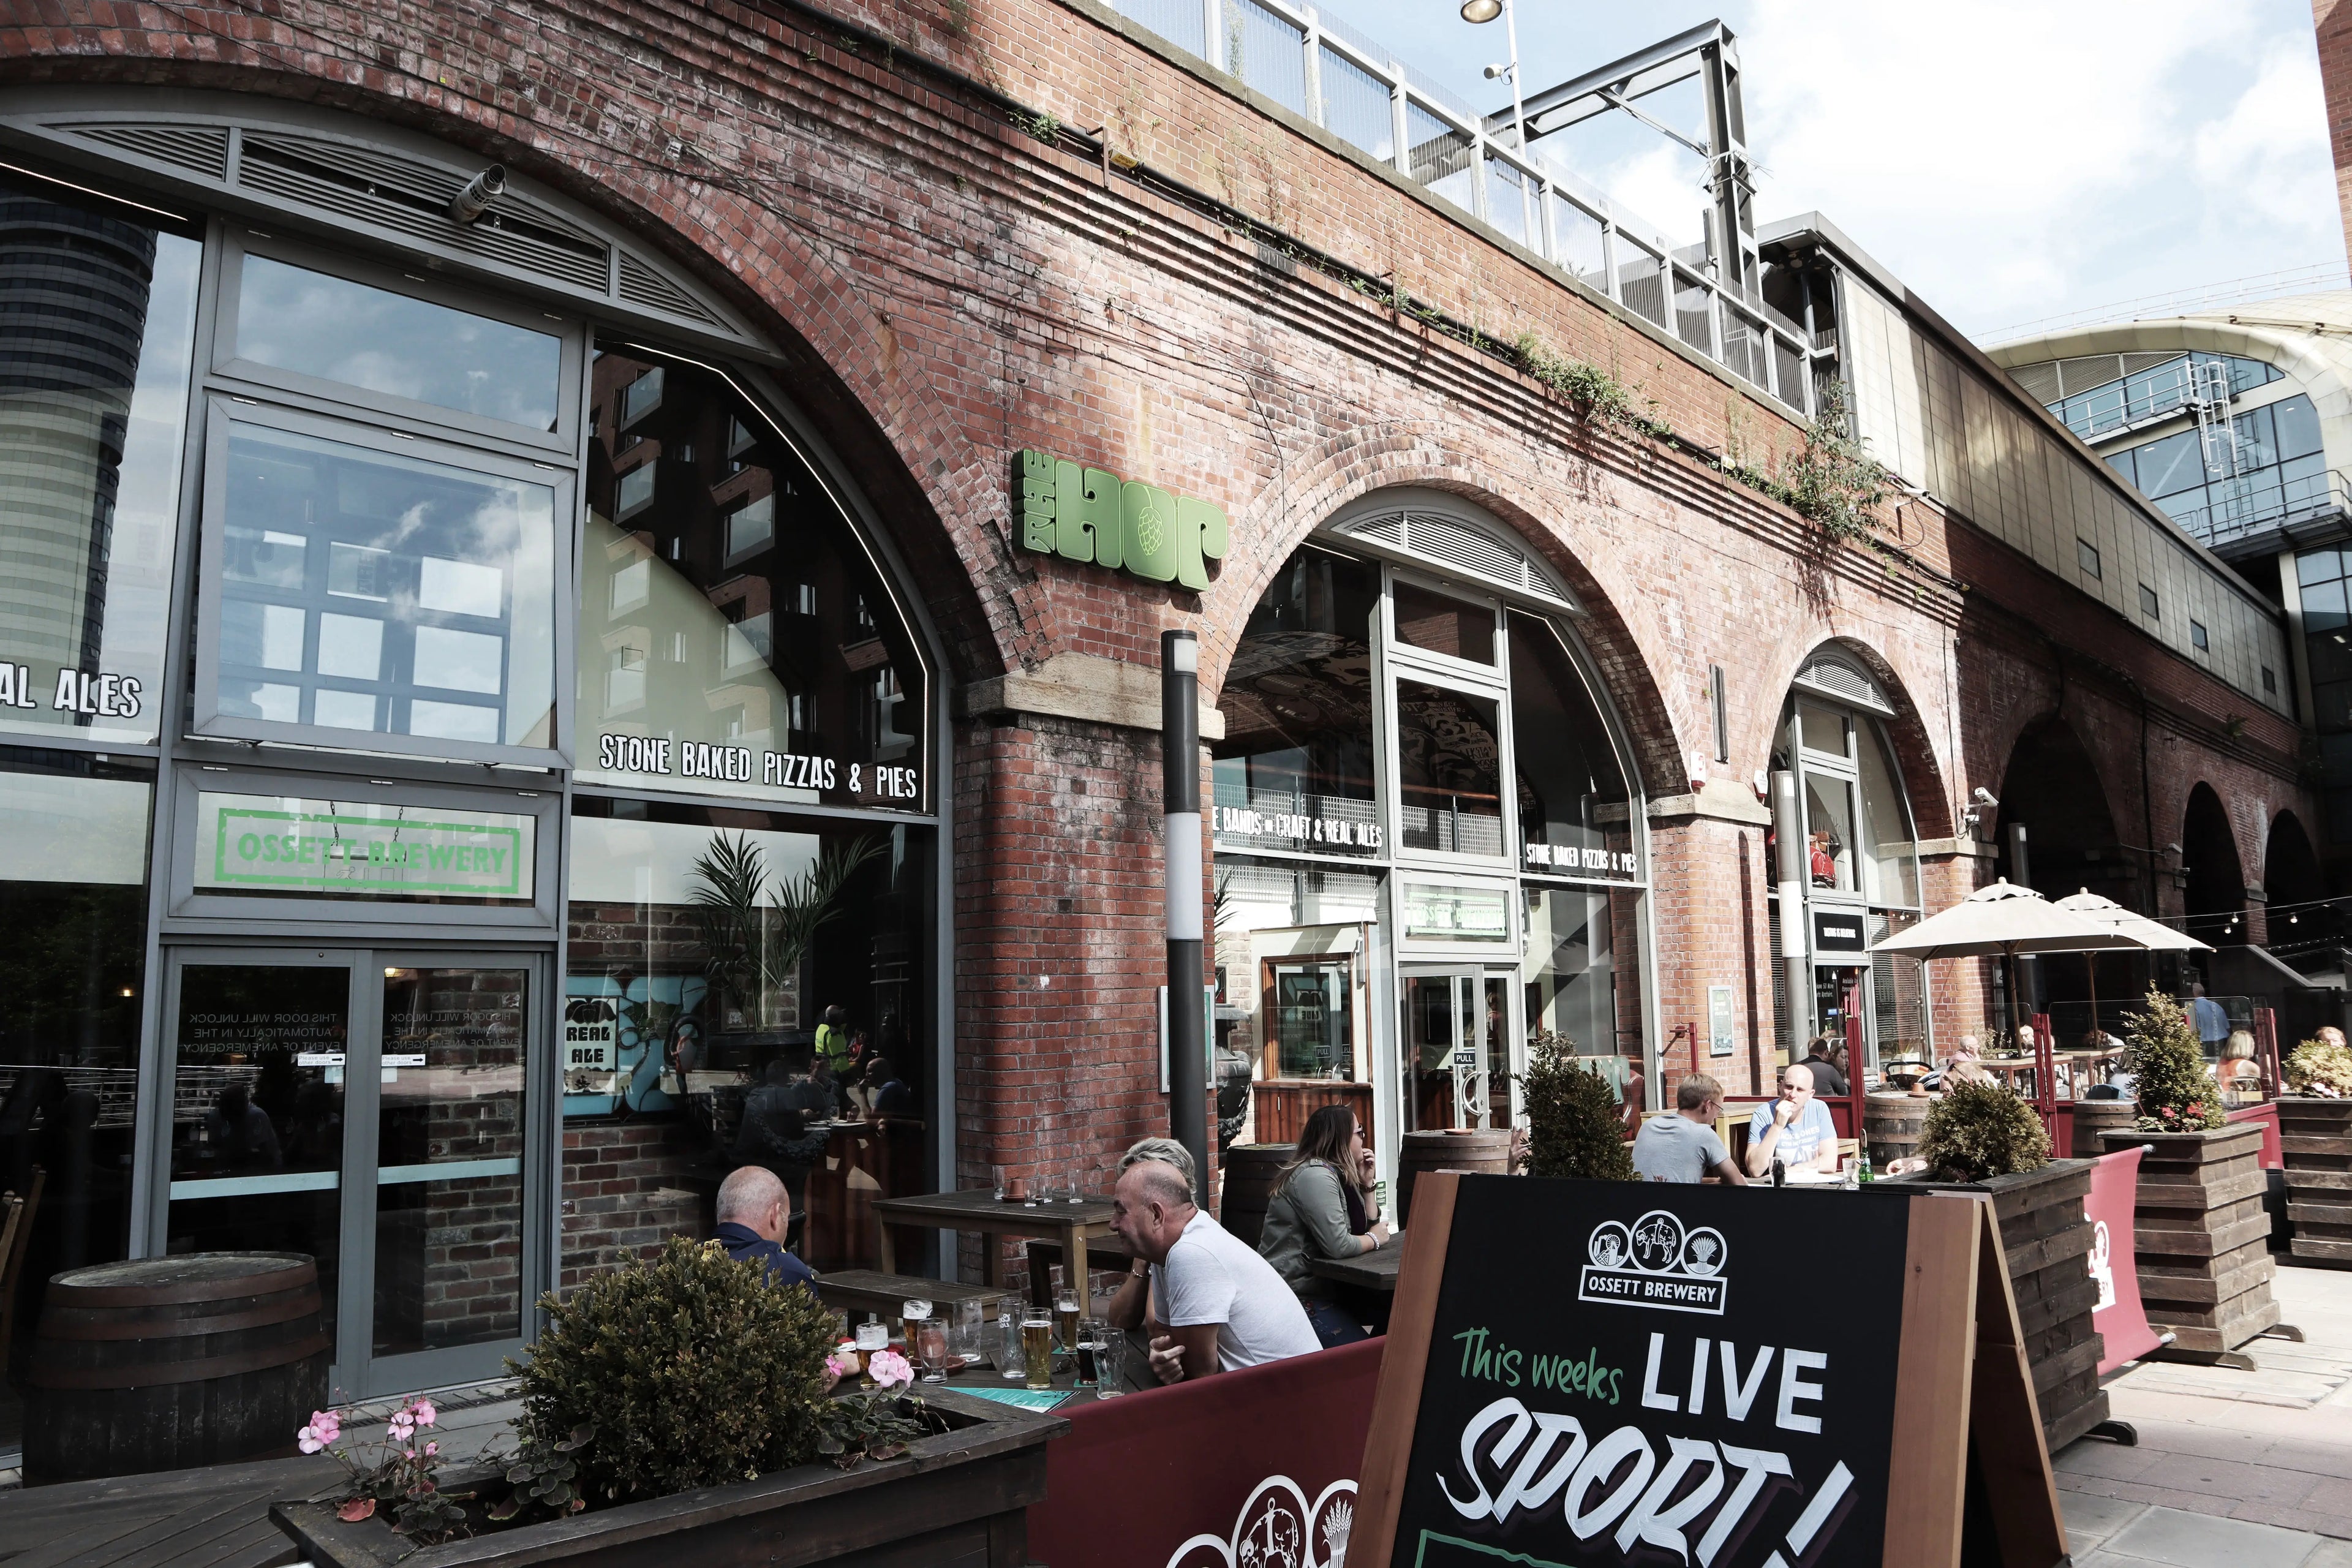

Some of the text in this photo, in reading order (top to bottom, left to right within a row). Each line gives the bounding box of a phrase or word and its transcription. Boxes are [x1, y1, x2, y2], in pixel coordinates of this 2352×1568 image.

[1022, 448, 1229, 590] THE HOP
[53, 668, 142, 718] ALES
[599, 734, 918, 799] STONE BAKED PIZZAS & PIES
[1223, 807, 1262, 835] BANDS
[1276, 813, 1311, 840] CRAFT
[1314, 818, 1322, 842] &
[1325, 819, 1354, 845] REAL
[1357, 823, 1383, 848] ALES
[237, 832, 508, 874] OSSETT BREWERY
[1526, 843, 1637, 873] STONE BAKED PIZZAS & PIES
[566, 1027, 610, 1041] REAL
[571, 1048, 604, 1063] ALE
[1588, 1275, 1717, 1303] OSSETT BREWERY
[1452, 1326, 1828, 1434] This weeks LIVE
